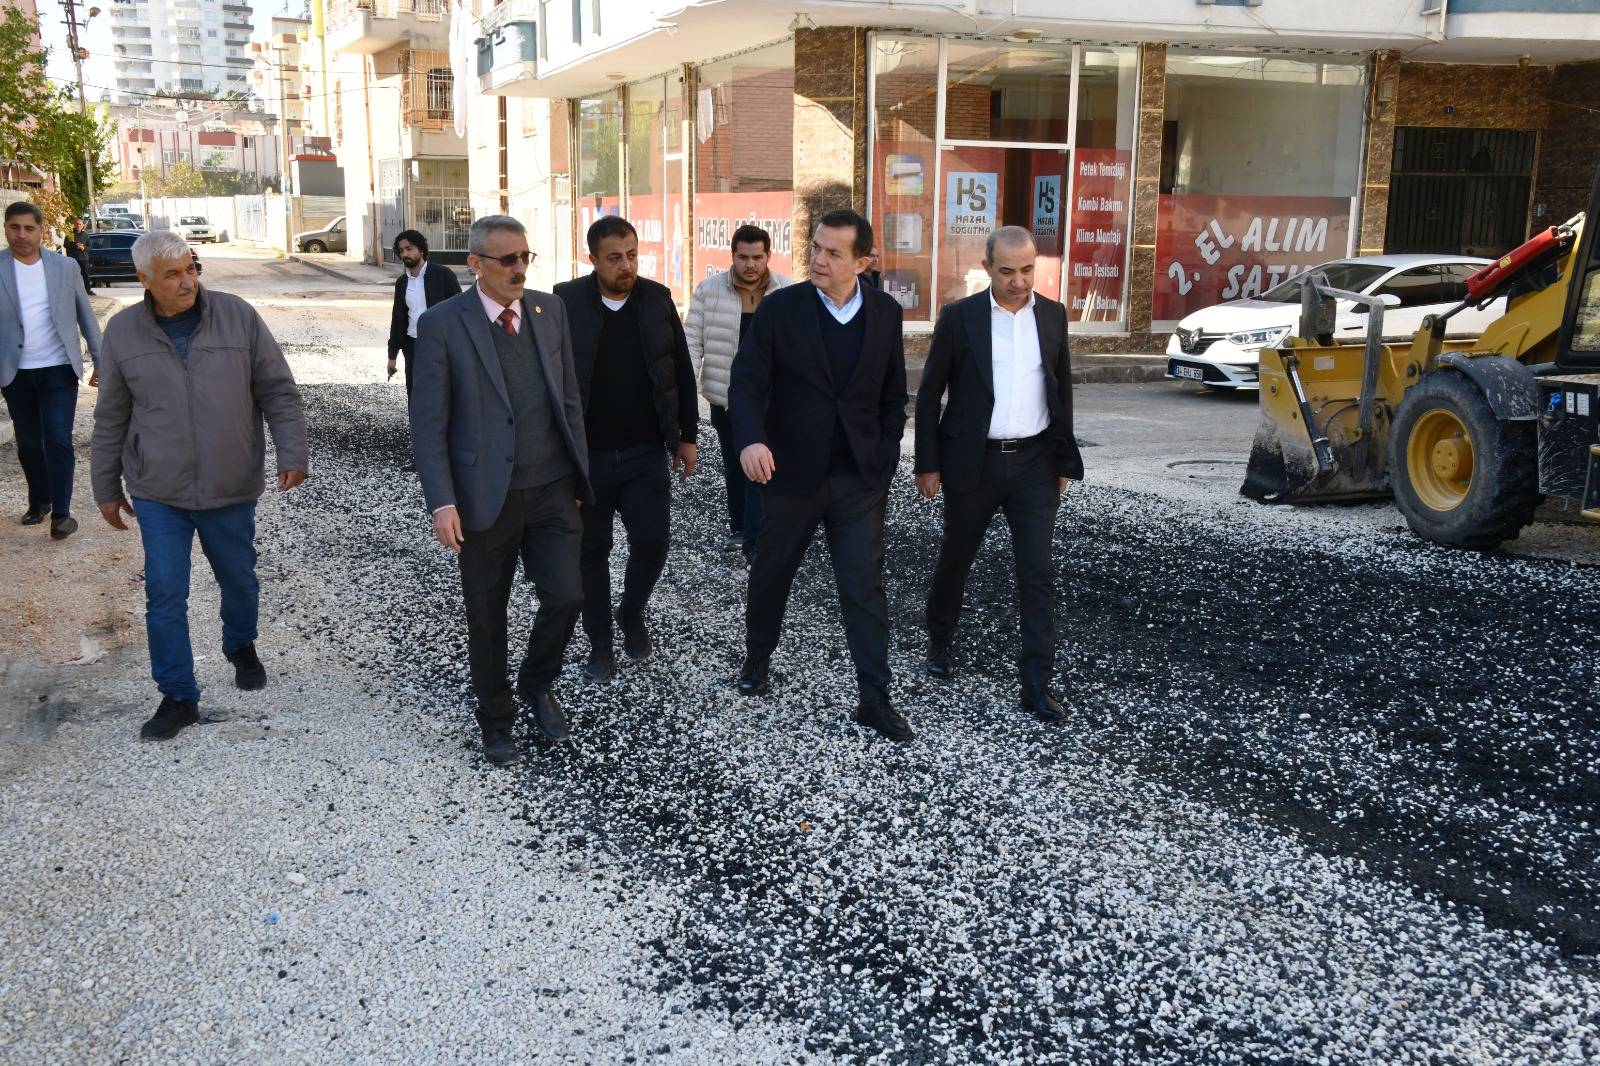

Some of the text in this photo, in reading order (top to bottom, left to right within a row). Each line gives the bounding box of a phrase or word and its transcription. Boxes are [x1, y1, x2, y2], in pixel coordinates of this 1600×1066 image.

[1080, 162, 1125, 180] Petek Temizliği
[956, 177, 987, 212] HS
[1038, 181, 1055, 214] HS
[1078, 196, 1123, 211] Kombi Bakımı
[955, 215, 987, 224] HAZAL
[1037, 217, 1054, 225] HAZAL
[698, 217, 731, 251] HAZAL
[1076, 228, 1121, 246] Klima Montajı
[1168, 217, 1329, 296] 2. EL ALIM
[1074, 262, 1119, 277] Klima Tesisatı
[1096, 295, 1118, 310] Bakım
